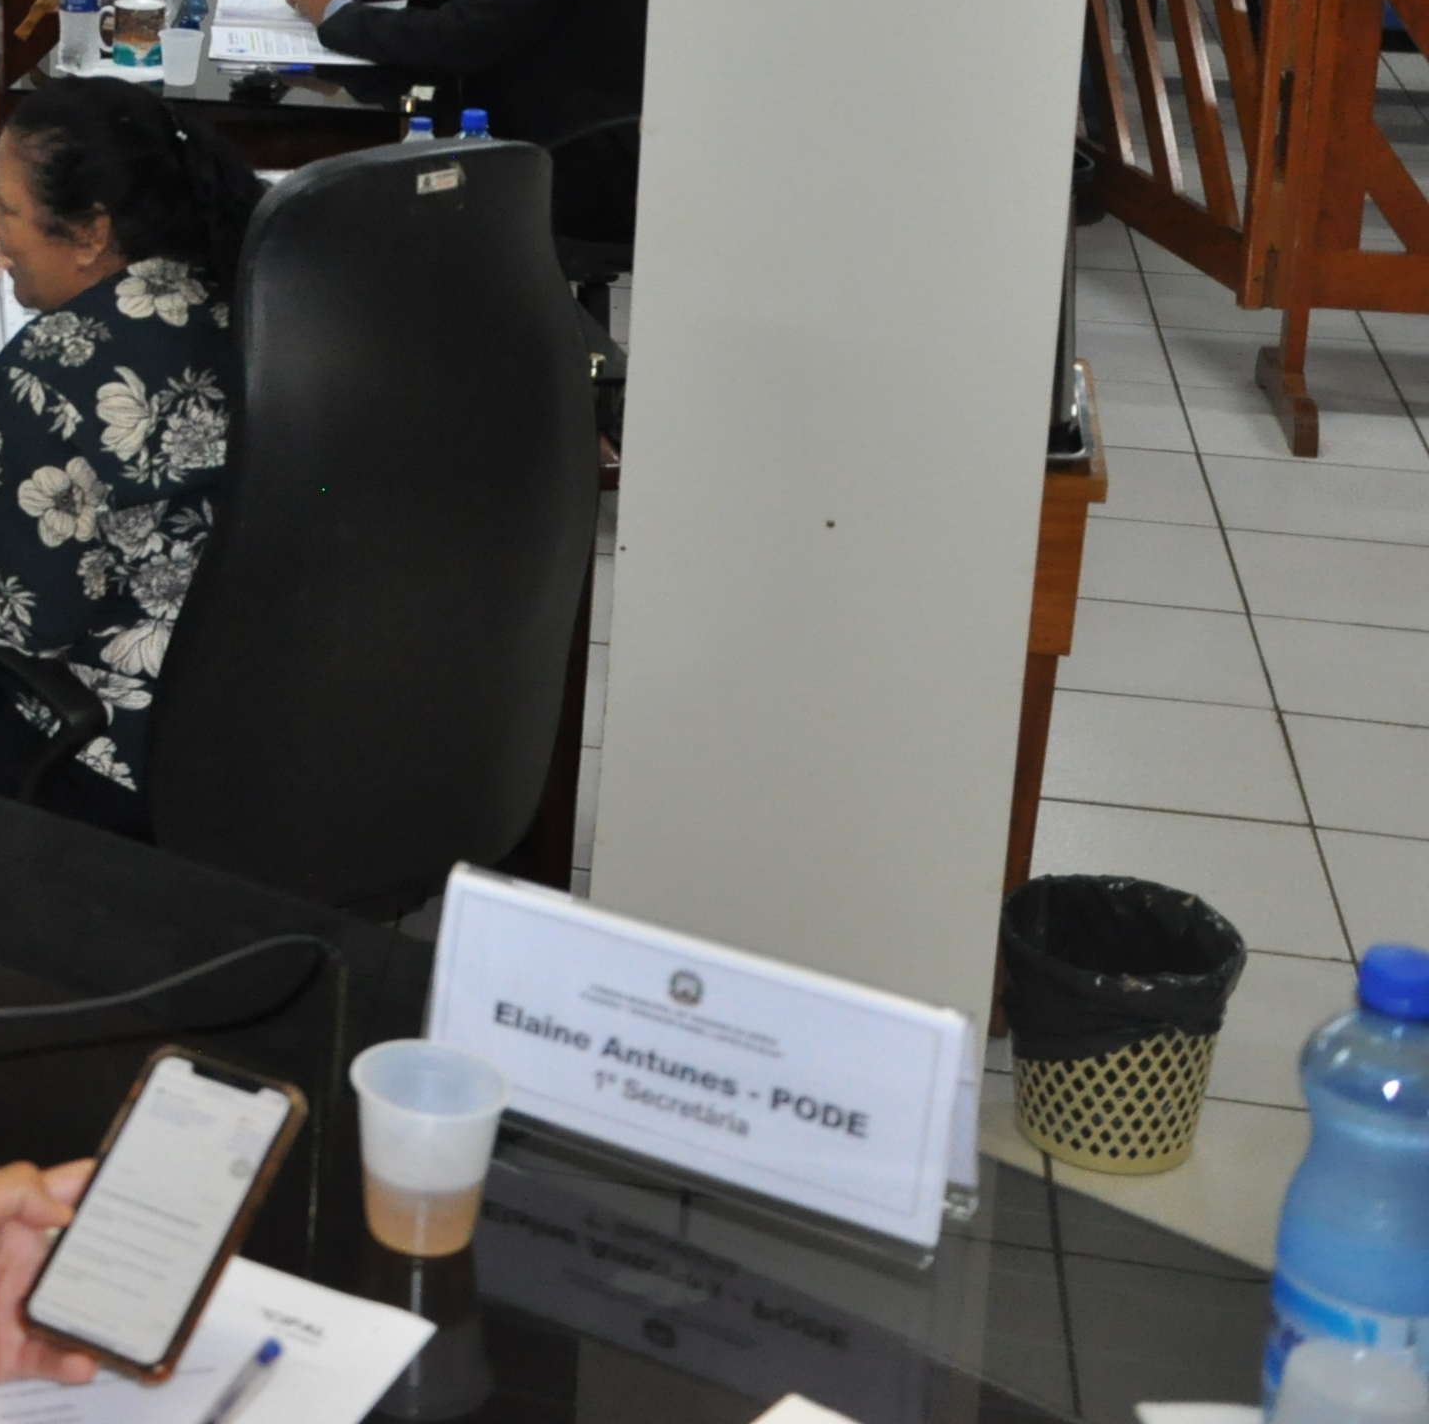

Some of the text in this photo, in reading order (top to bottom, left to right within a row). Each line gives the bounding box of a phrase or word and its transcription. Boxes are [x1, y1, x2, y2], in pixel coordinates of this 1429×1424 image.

[493, 1000, 591, 1051] Elaine
[601, 1035, 739, 1098] Antunes
[770, 1086, 871, 1138] PODE
